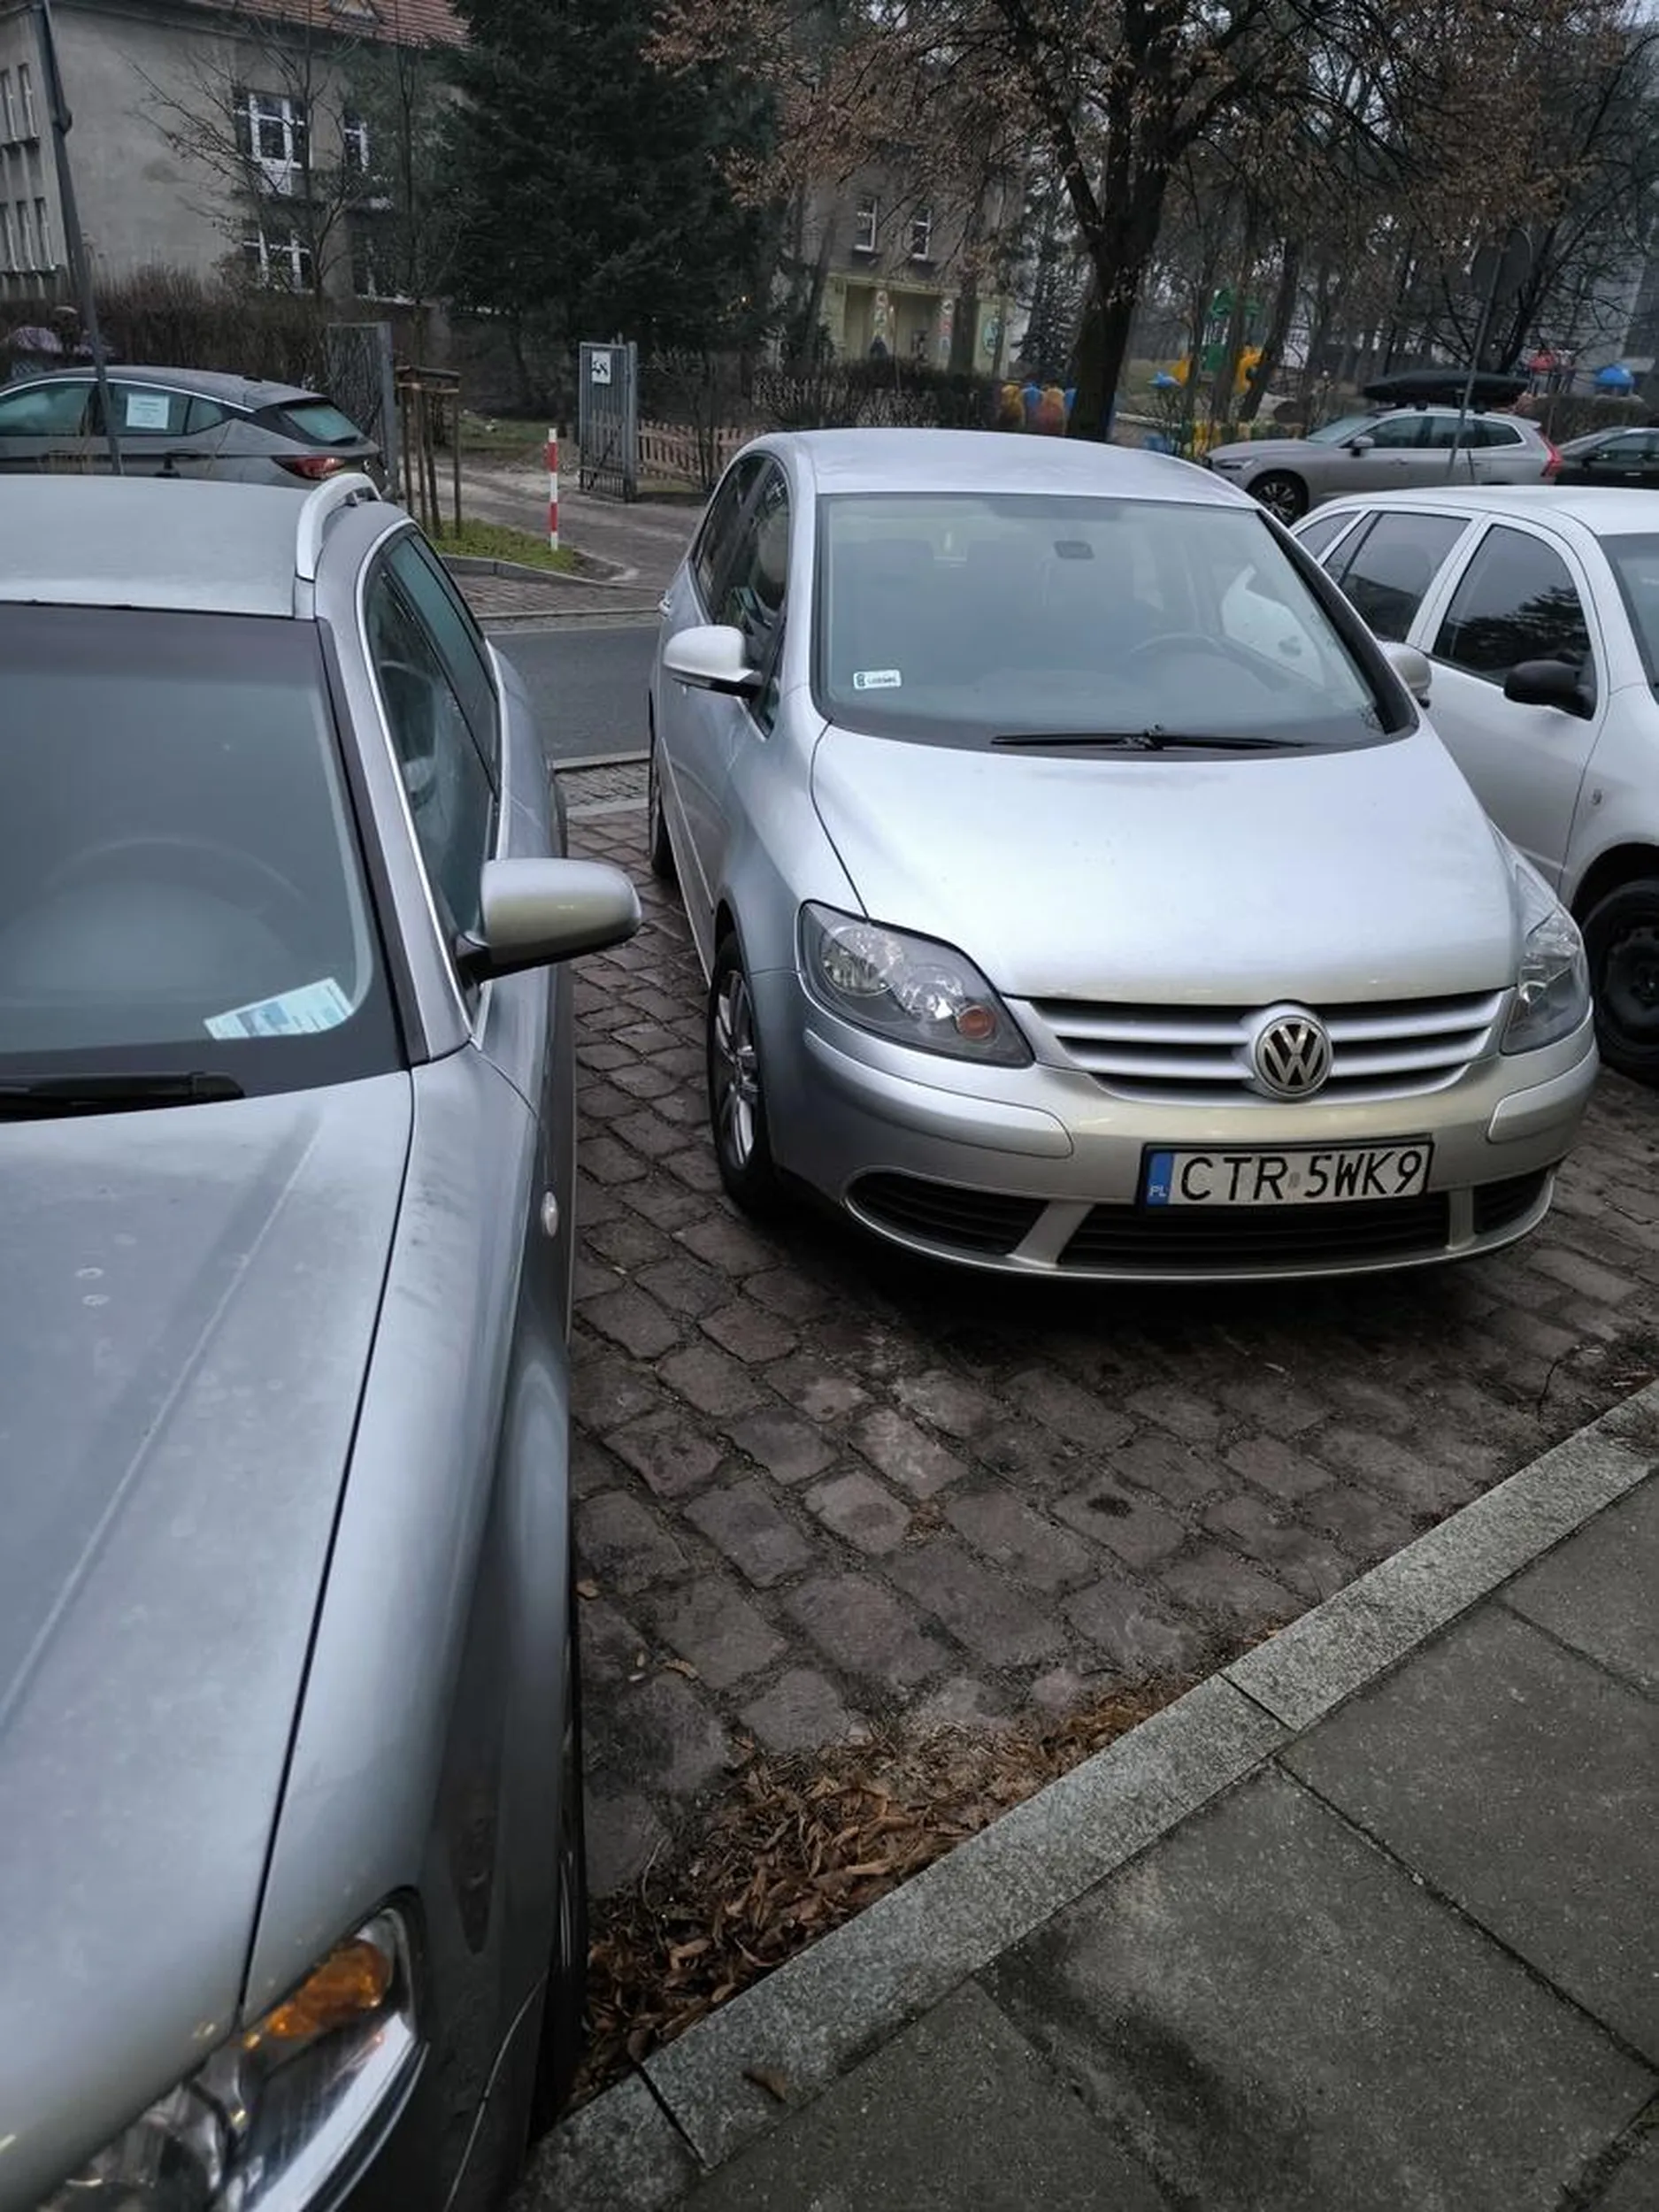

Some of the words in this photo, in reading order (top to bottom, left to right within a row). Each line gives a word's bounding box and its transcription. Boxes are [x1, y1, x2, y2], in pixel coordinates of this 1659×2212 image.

[1149, 1185, 1167, 1197] PL
[1180, 1156, 1288, 1202] CTR
[1303, 1149, 1423, 1199] 5WK9
